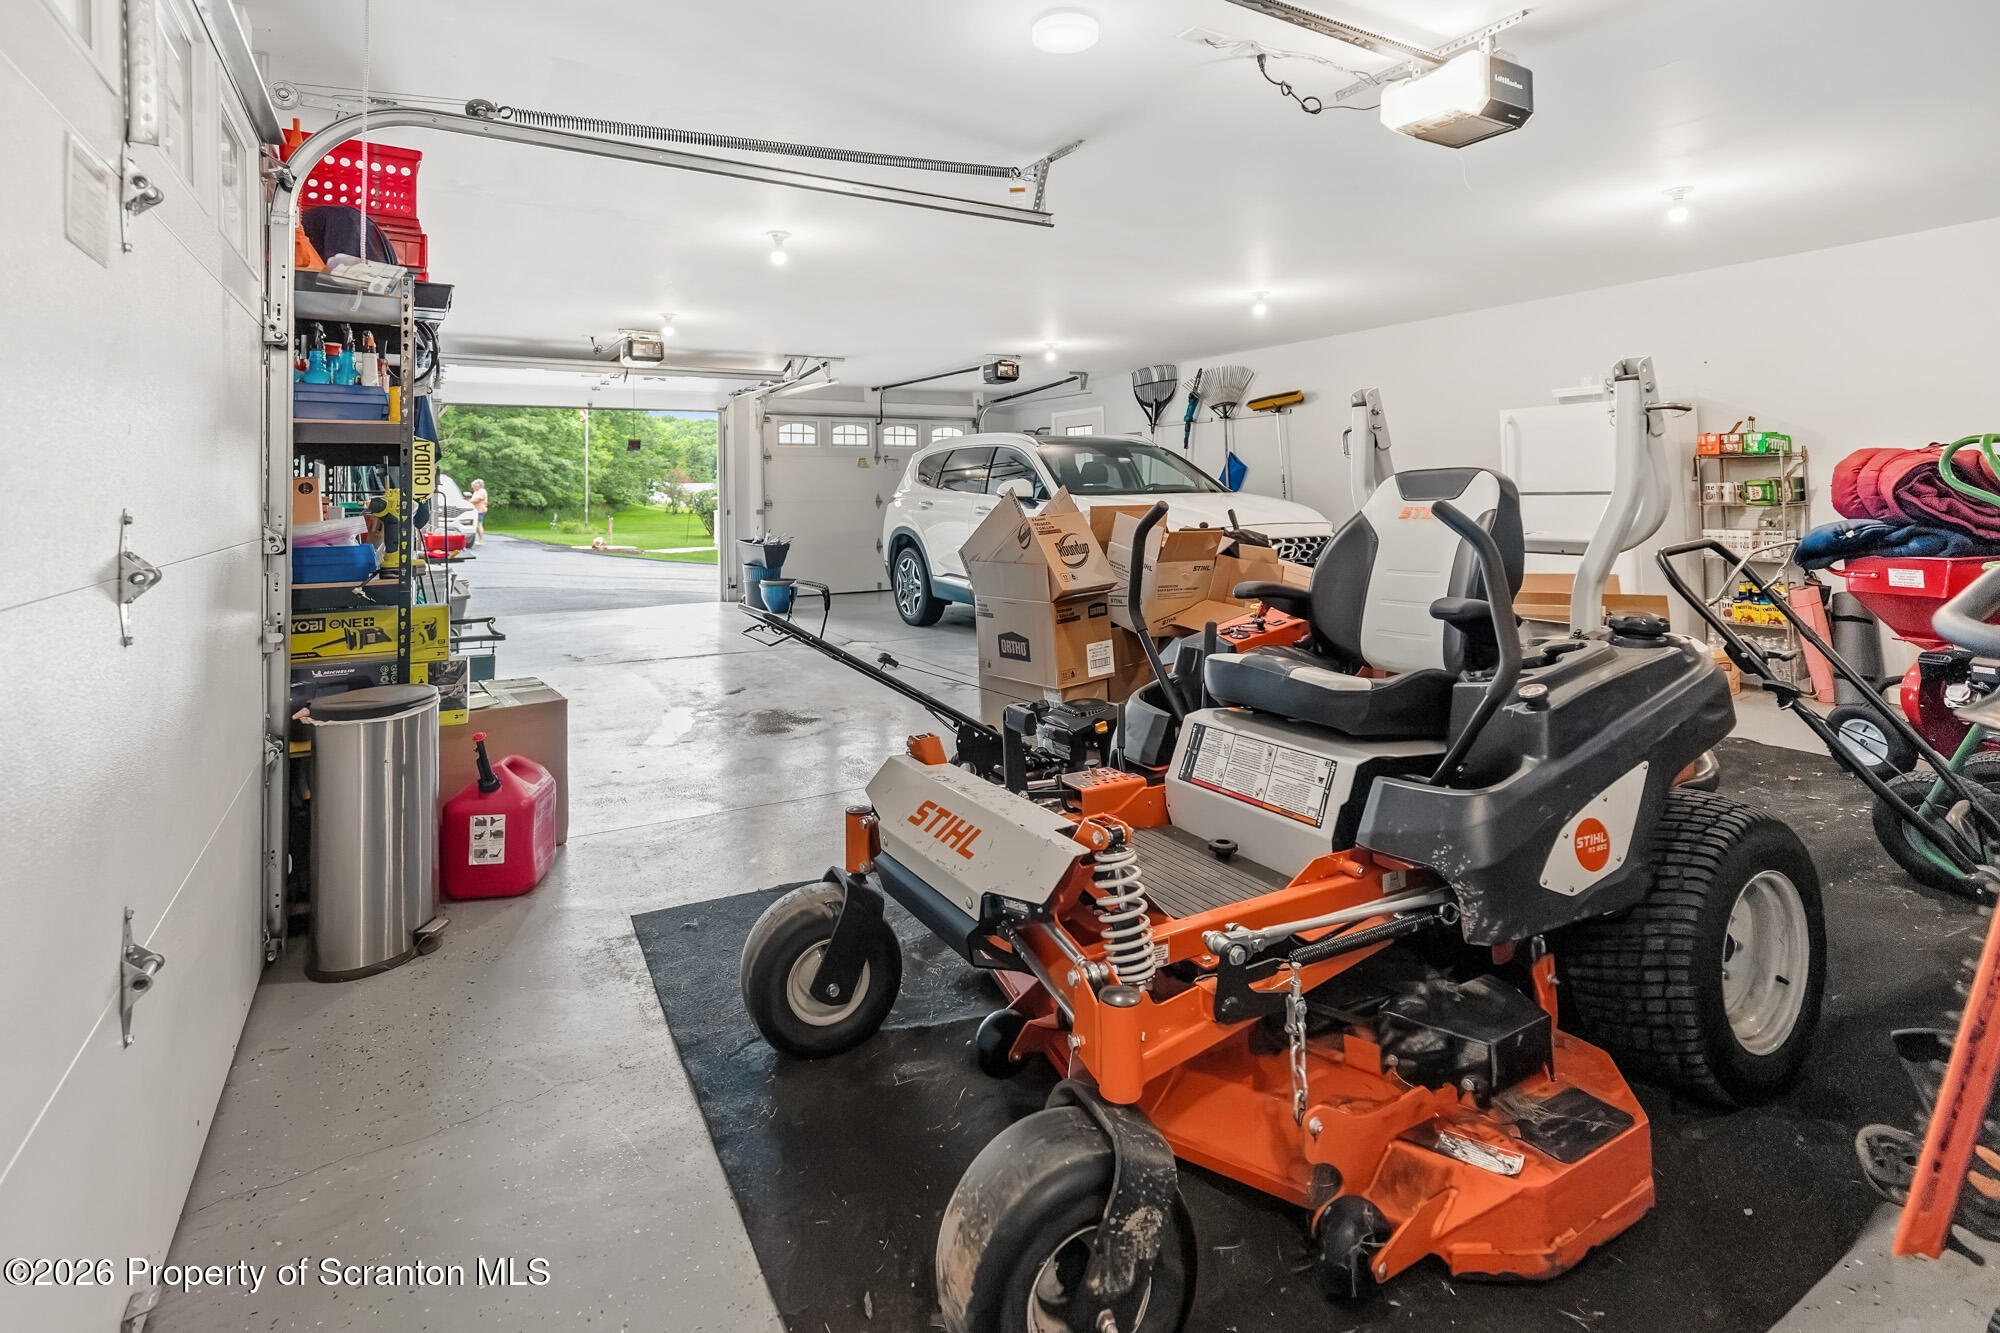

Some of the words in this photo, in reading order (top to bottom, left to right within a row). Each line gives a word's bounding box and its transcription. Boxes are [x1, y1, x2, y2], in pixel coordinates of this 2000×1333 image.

[1054, 539, 1090, 558] Roundup
[292, 620, 323, 632] YOBI
[1001, 639, 1027, 657] ORTHO
[907, 799, 982, 861] STIHL
[1576, 832, 1608, 849] STIHL
